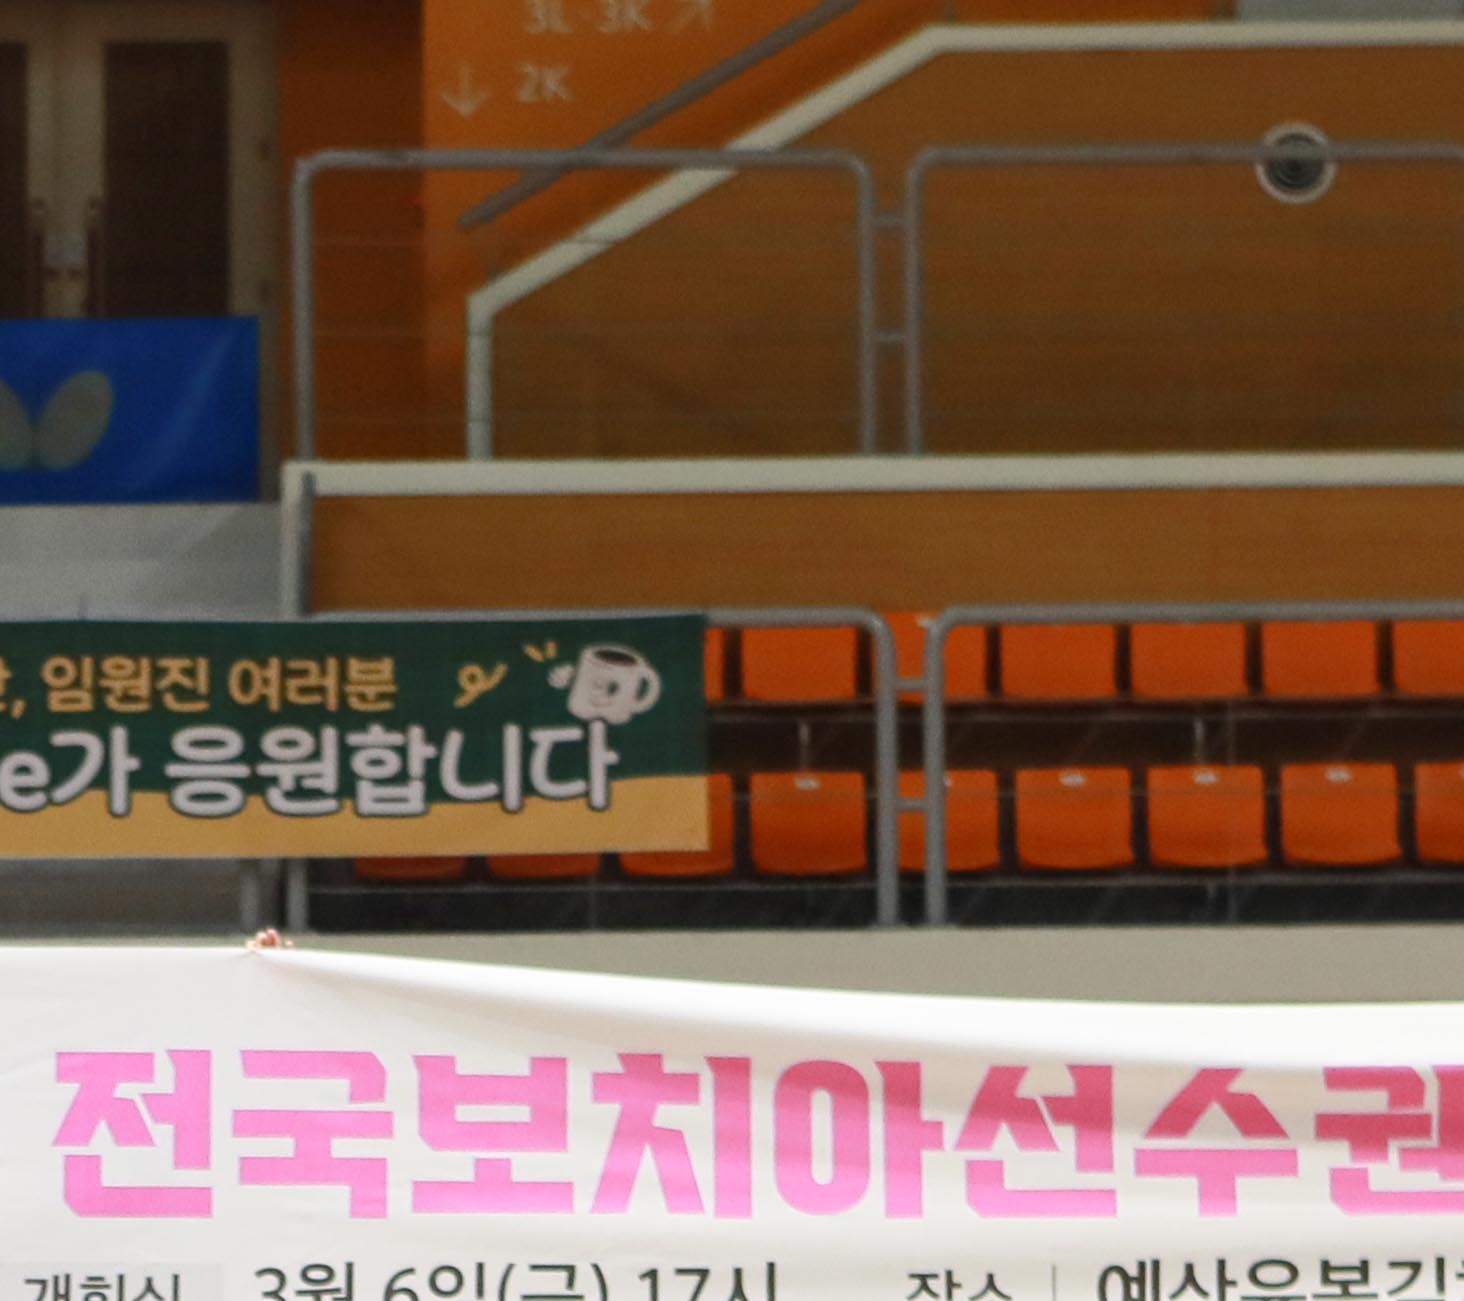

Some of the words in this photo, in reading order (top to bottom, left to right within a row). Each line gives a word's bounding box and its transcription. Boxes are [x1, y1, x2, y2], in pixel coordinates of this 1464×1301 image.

[40, 656, 210, 714] 임원진
[227, 656, 398, 713] 여러분
[164, 718, 619, 818] 응원합니다
